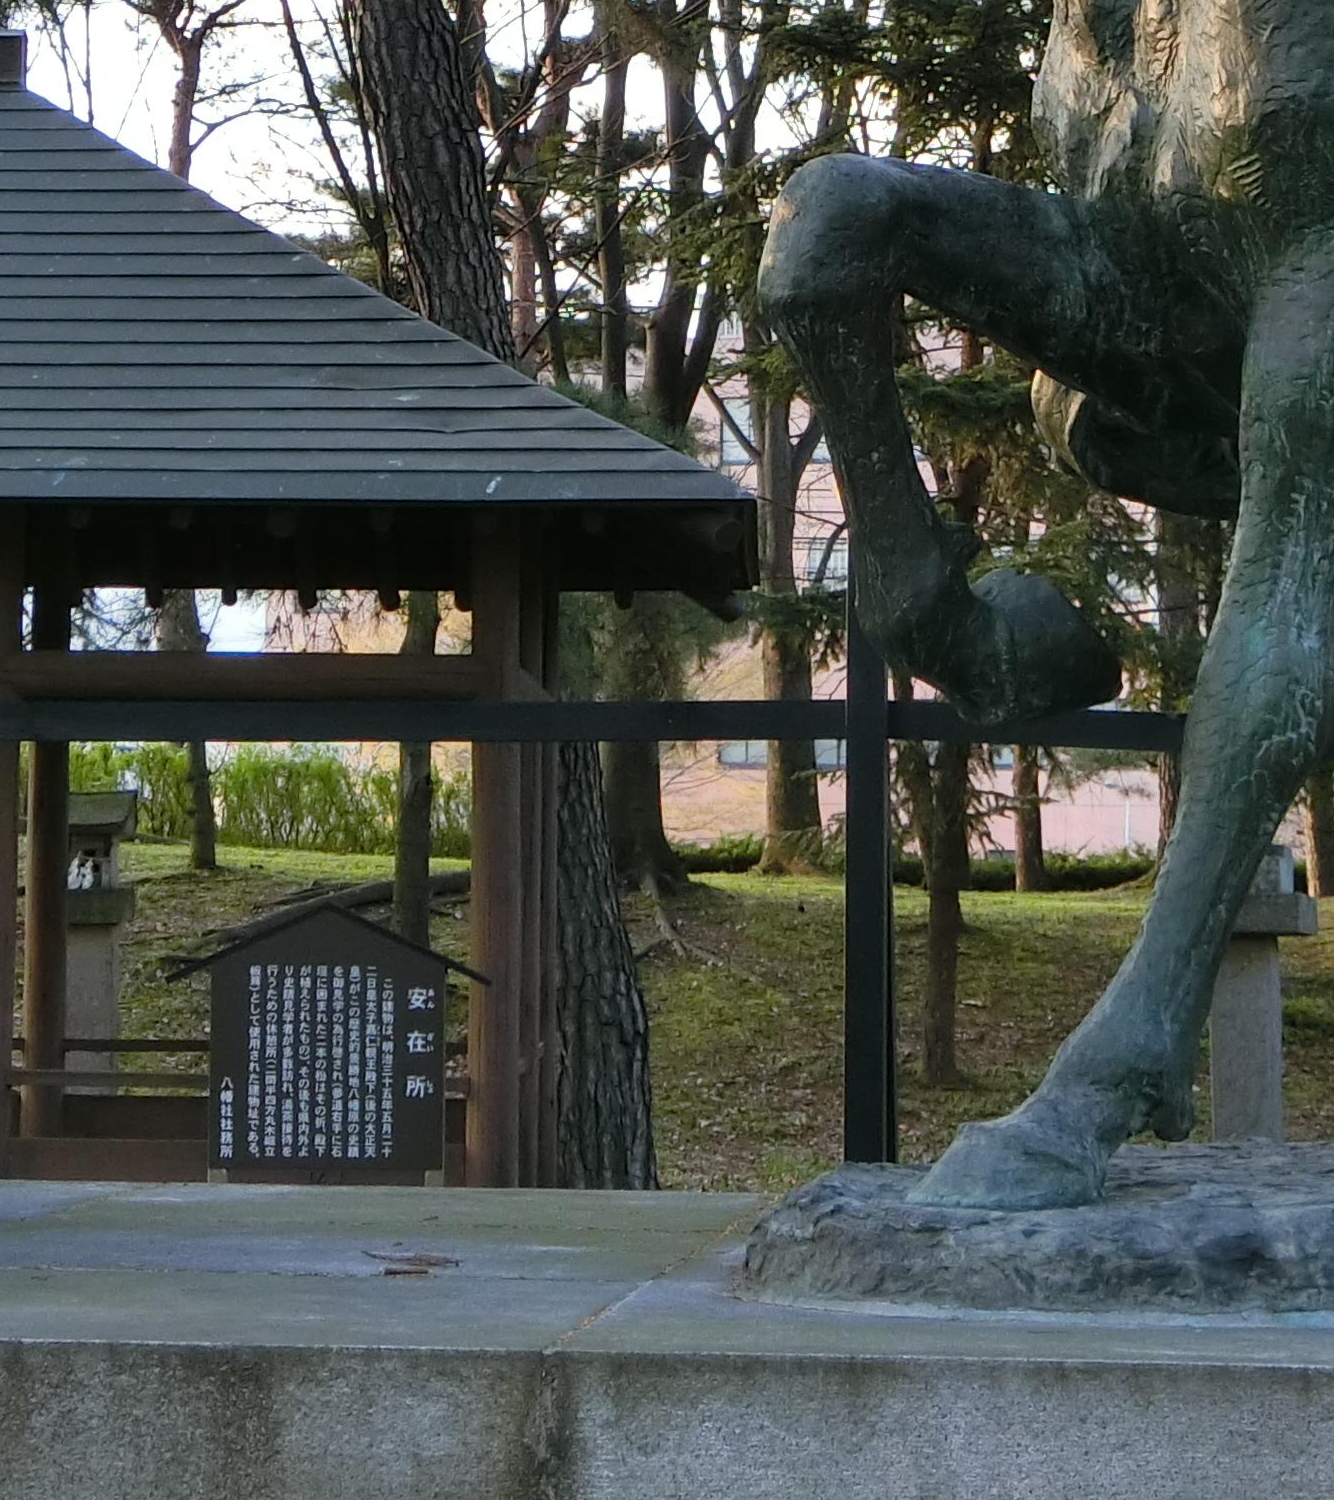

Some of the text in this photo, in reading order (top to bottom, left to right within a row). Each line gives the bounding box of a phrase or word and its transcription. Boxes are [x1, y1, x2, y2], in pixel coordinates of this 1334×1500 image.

[405, 986, 427, 1098] 安在所
[219, 1076, 234, 1158] 八幡社社務所
